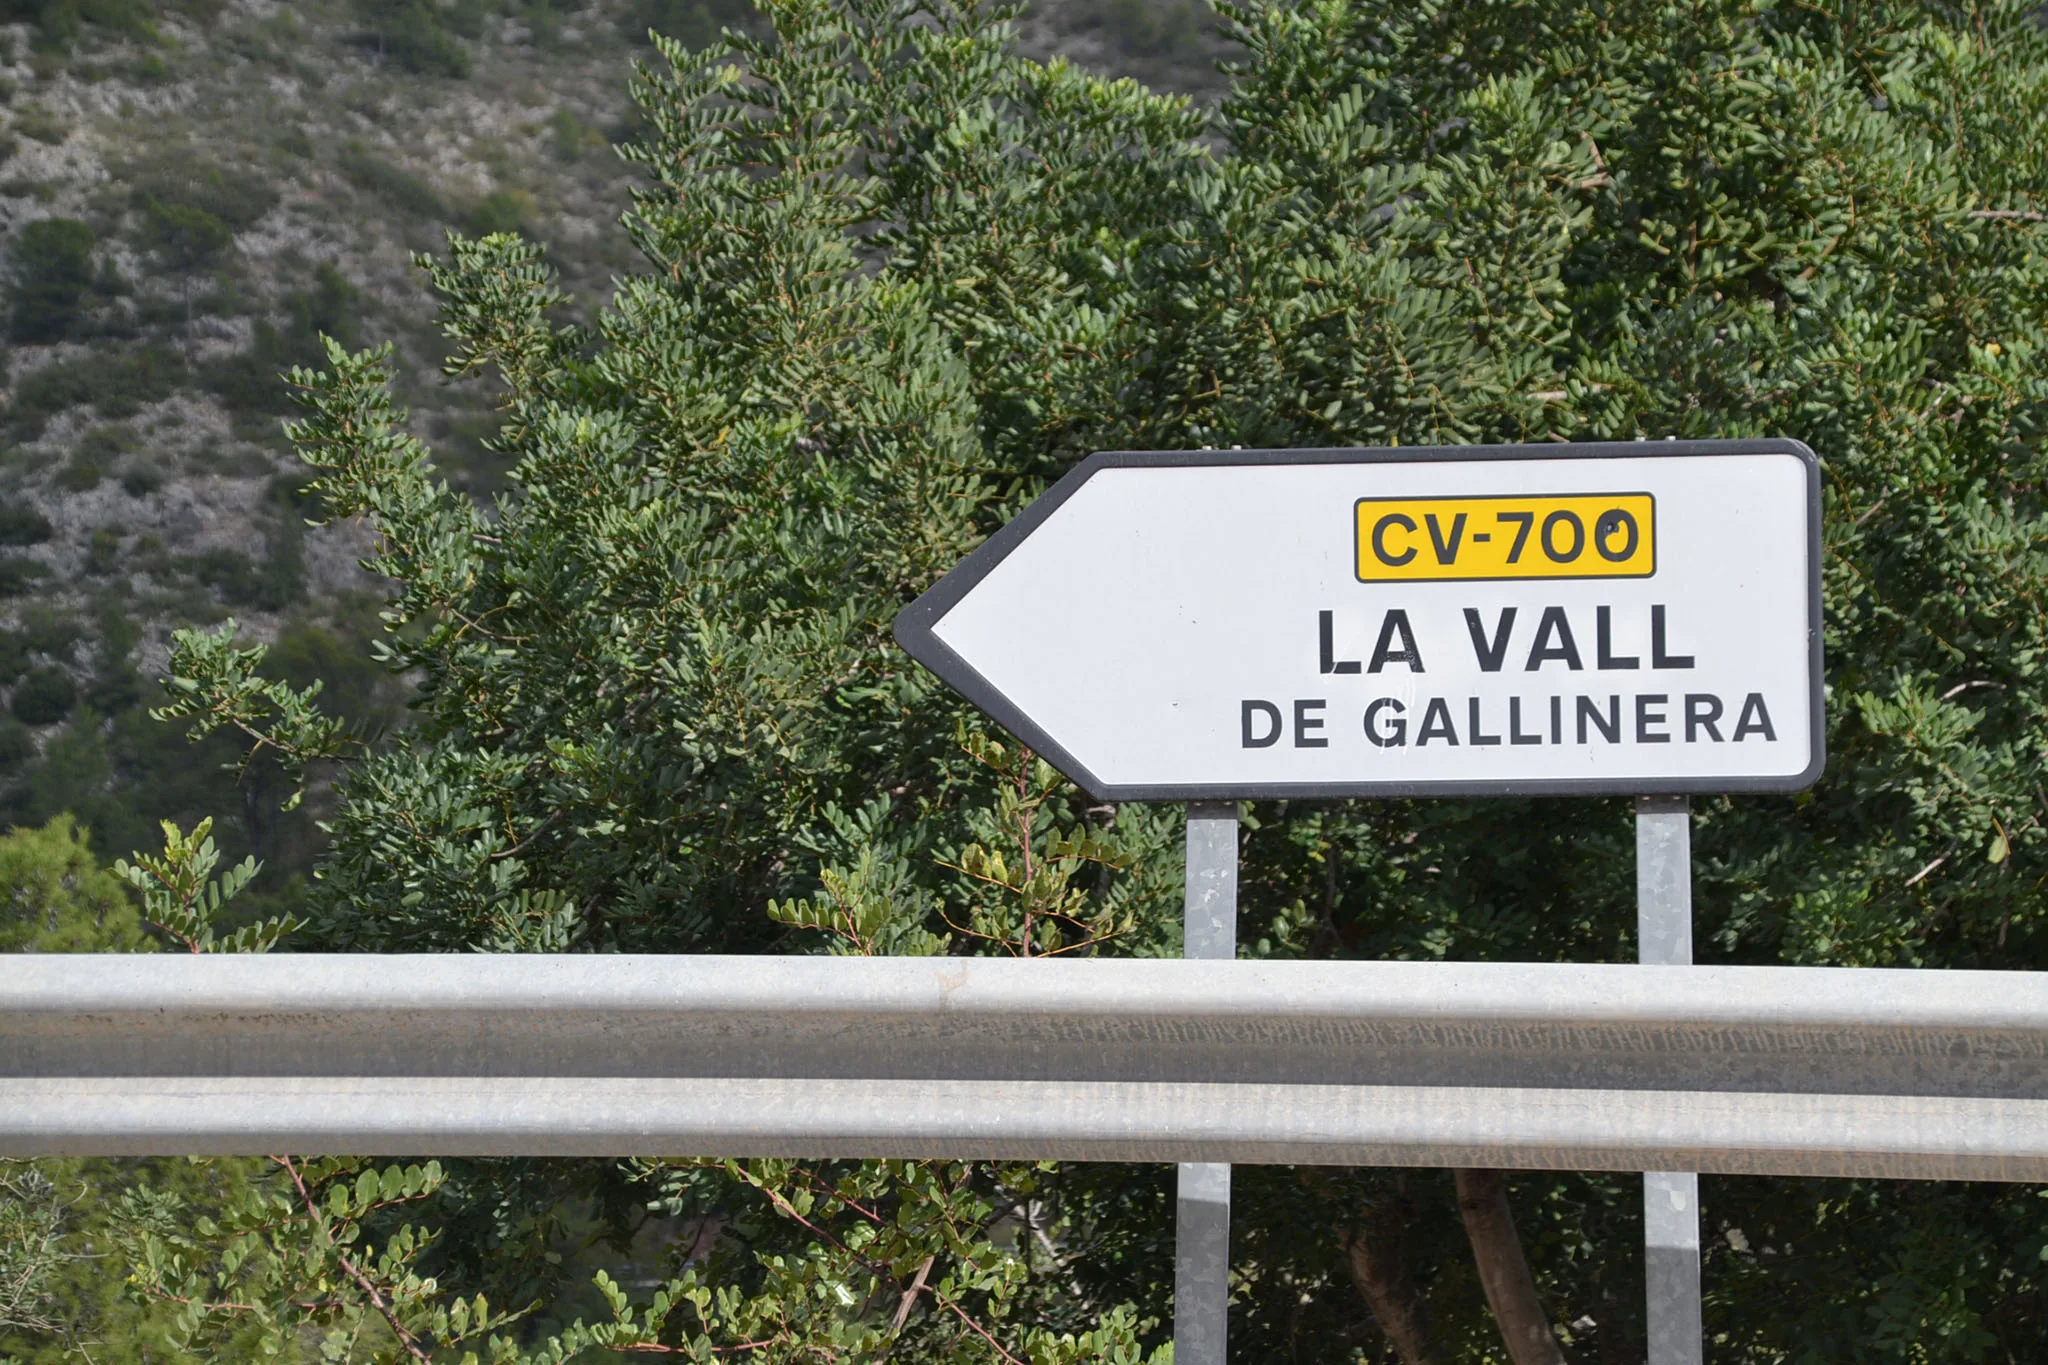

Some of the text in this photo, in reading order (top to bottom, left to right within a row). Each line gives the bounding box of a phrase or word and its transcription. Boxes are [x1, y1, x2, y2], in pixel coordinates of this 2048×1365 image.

[1371, 508, 1639, 567] CV-700
[1319, 604, 1696, 674] LA VALL
[1241, 693, 1778, 748] DE GALLINERA
